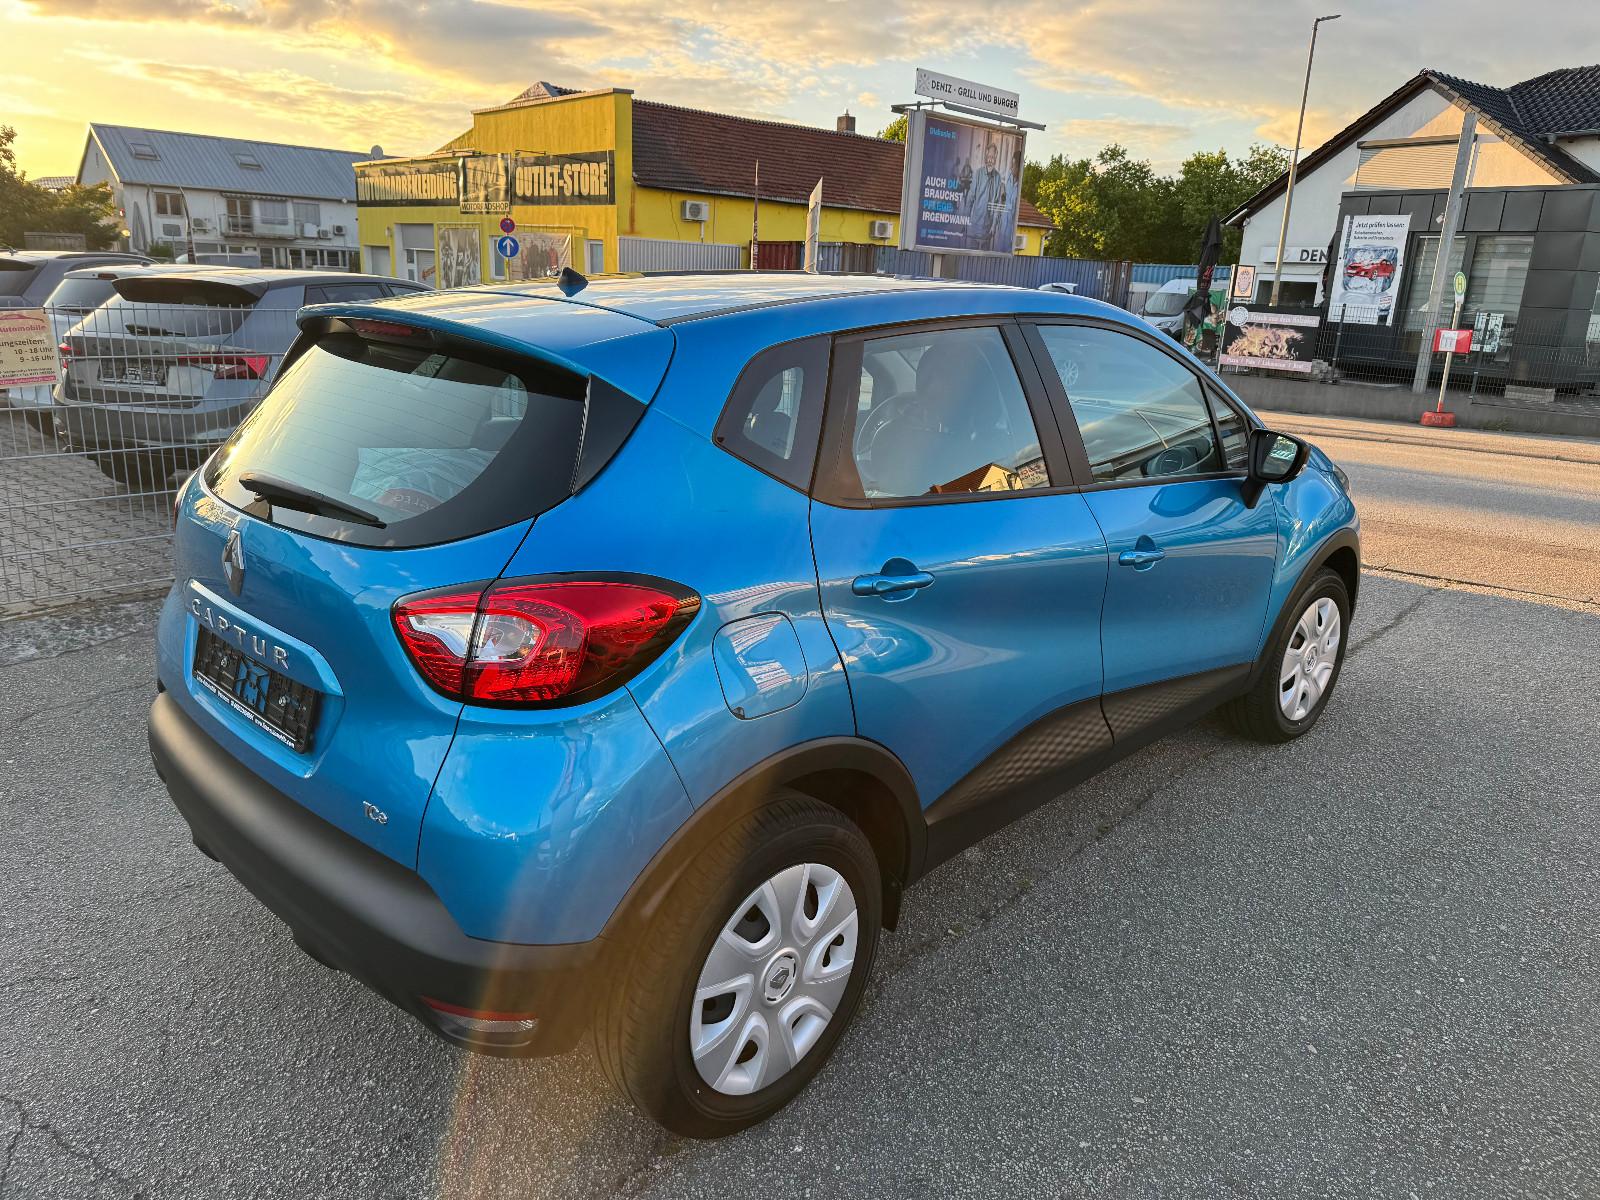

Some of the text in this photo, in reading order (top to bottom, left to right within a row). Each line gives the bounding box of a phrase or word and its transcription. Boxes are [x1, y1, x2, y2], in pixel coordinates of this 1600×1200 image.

[931, 80, 952, 93] DENIZ
[958, 86, 977, 100] GRILL
[978, 91, 992, 103] UND
[993, 94, 1018, 109] BURGER
[357, 171, 458, 200] MOTORRADBEKLEIDUNG
[515, 162, 608, 197] OUTLET-STORE
[925, 176, 959, 190] AUCH DU
[924, 188, 964, 201] BRAUCHST
[922, 211, 972, 225] IRGENDWANN.
[1355, 221, 1369, 229] Jetzt
[192, 598, 288, 670] CAPTUR
